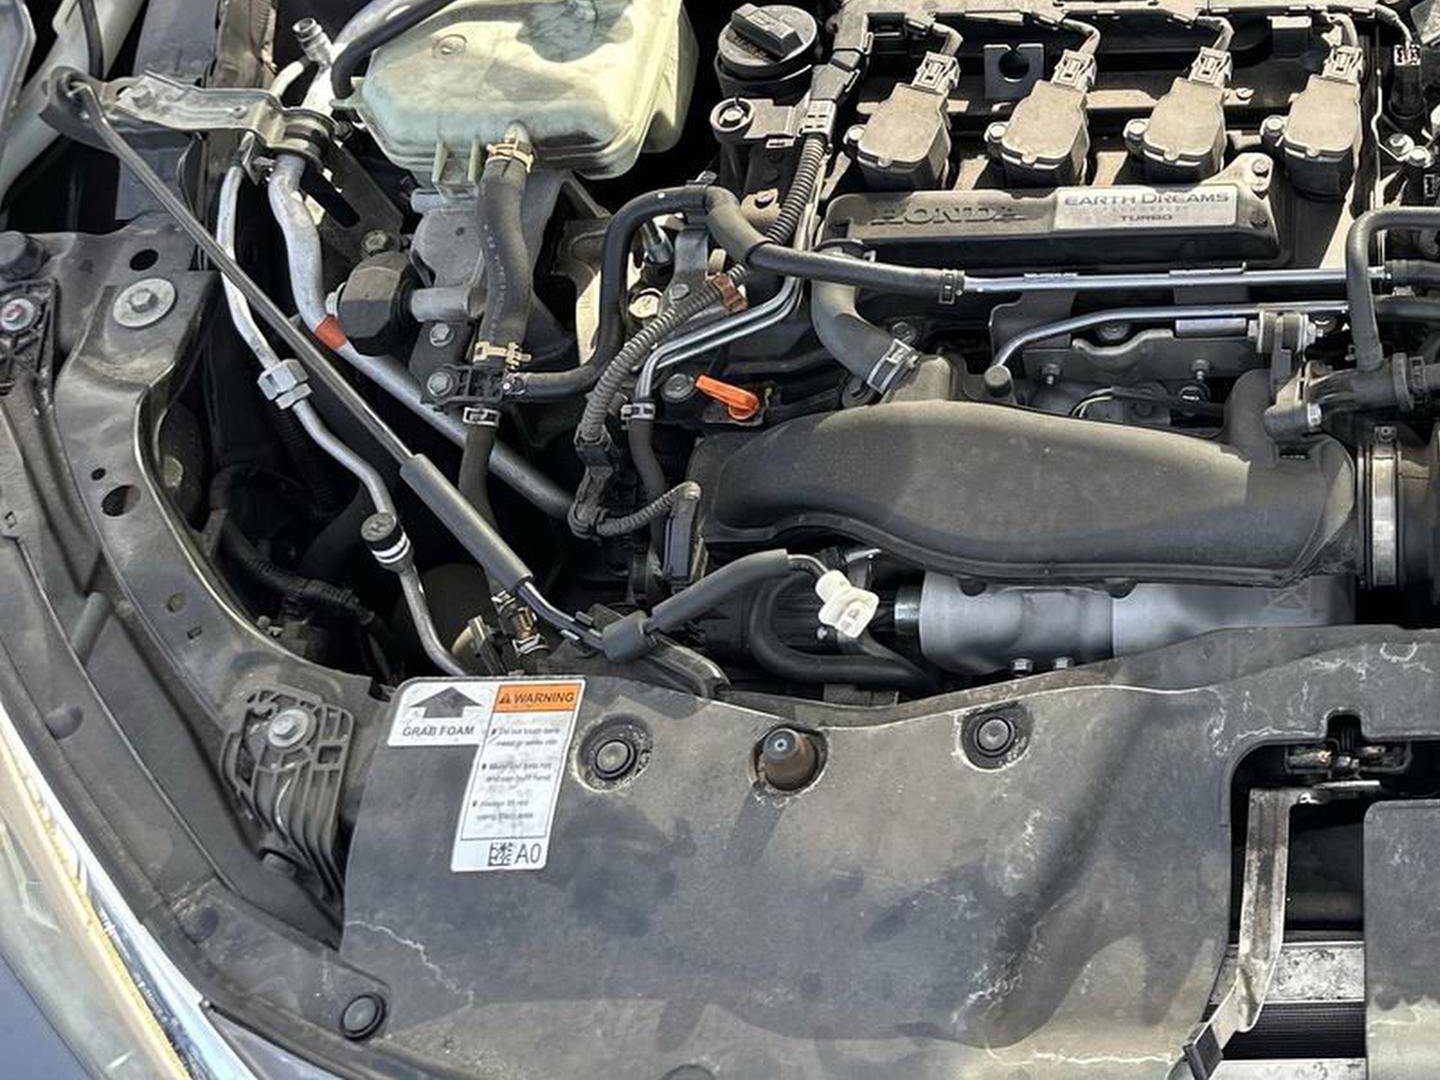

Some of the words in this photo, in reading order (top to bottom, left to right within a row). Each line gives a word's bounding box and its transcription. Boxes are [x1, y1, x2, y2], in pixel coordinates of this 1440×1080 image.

[1064, 194, 1136, 207] EARTH
[1141, 191, 1230, 205] DREAMS
[1120, 213, 1173, 222] TURBO
[513, 691, 576, 704] WARNING
[402, 725, 437, 737] GRAB
[438, 725, 475, 736] FOAM
